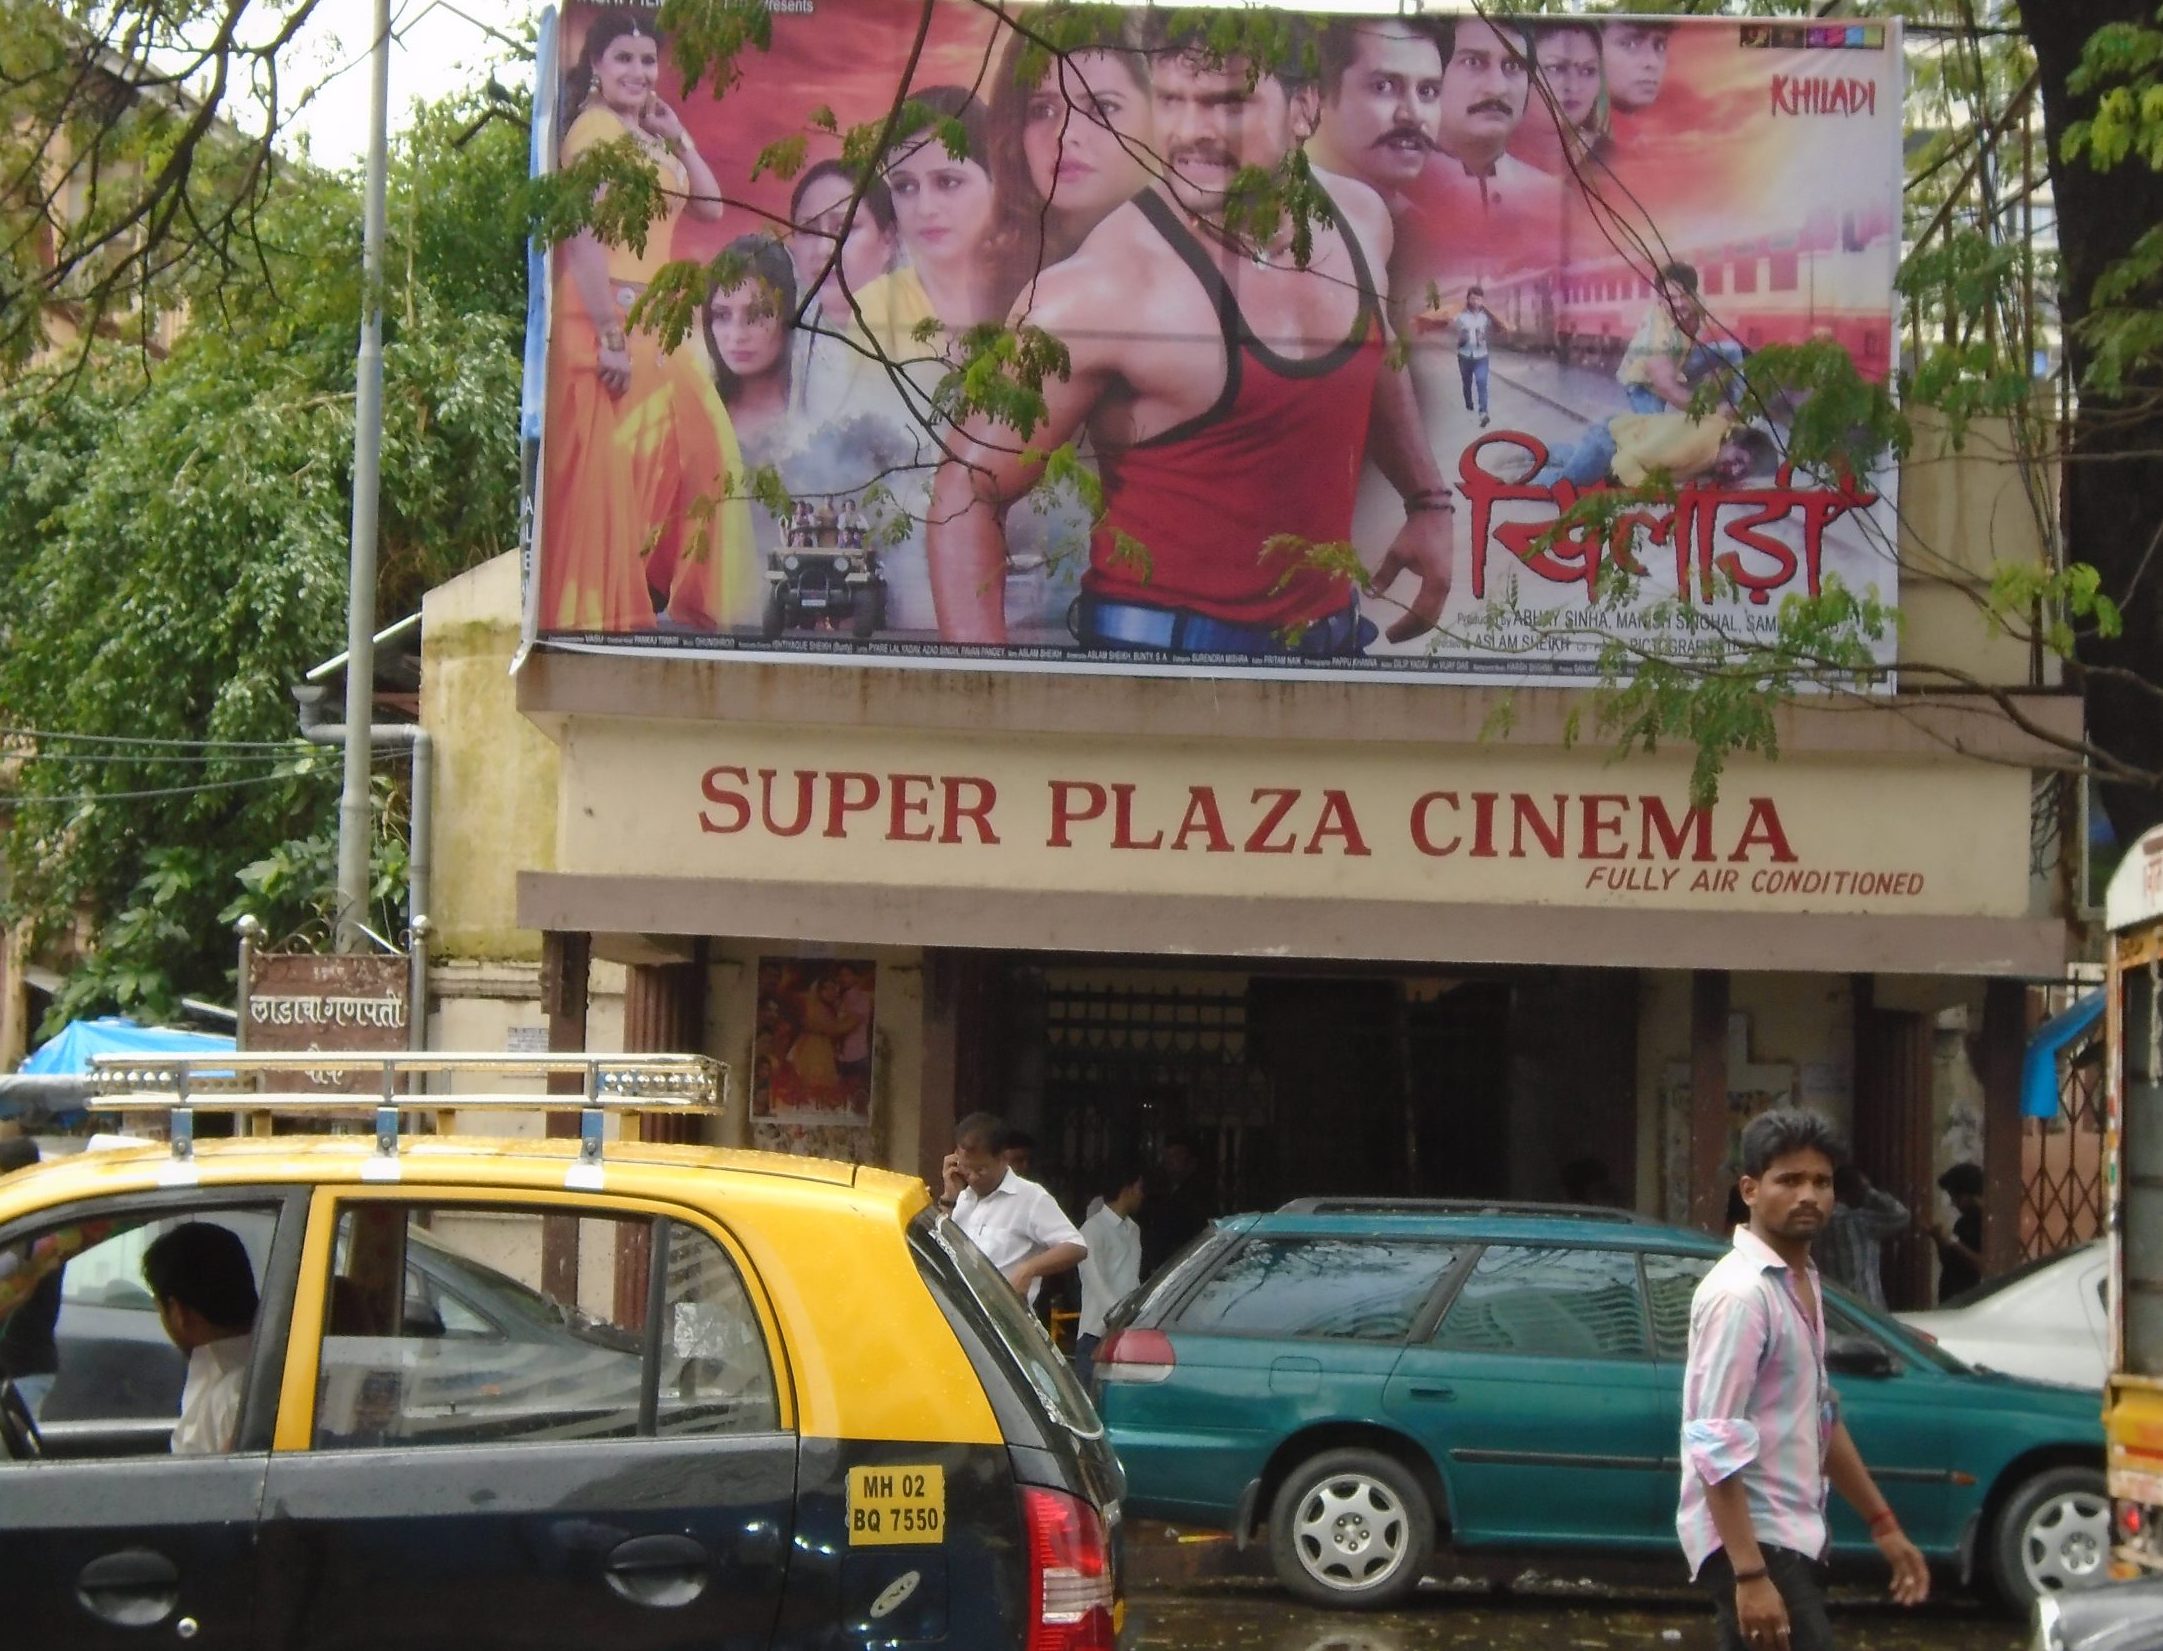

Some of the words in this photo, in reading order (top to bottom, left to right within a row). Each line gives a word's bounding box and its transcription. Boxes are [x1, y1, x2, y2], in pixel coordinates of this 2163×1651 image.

[1771, 73, 1876, 118] KHILADI
[1565, 610, 1612, 630] SINHA,
[699, 765, 1000, 845] SUPER
[1046, 779, 1372, 857] PLAZA
[1410, 791, 1798, 862] CINEMA
[1586, 866, 1680, 891] FULLY
[1690, 869, 1739, 893] AIR
[1751, 869, 1924, 896] CONDITIONED
[863, 1475, 893, 1498] MH
[902, 1475, 925, 1498] 02
[853, 1508, 881, 1533] BQ
[890, 1507, 938, 1531] 7550
